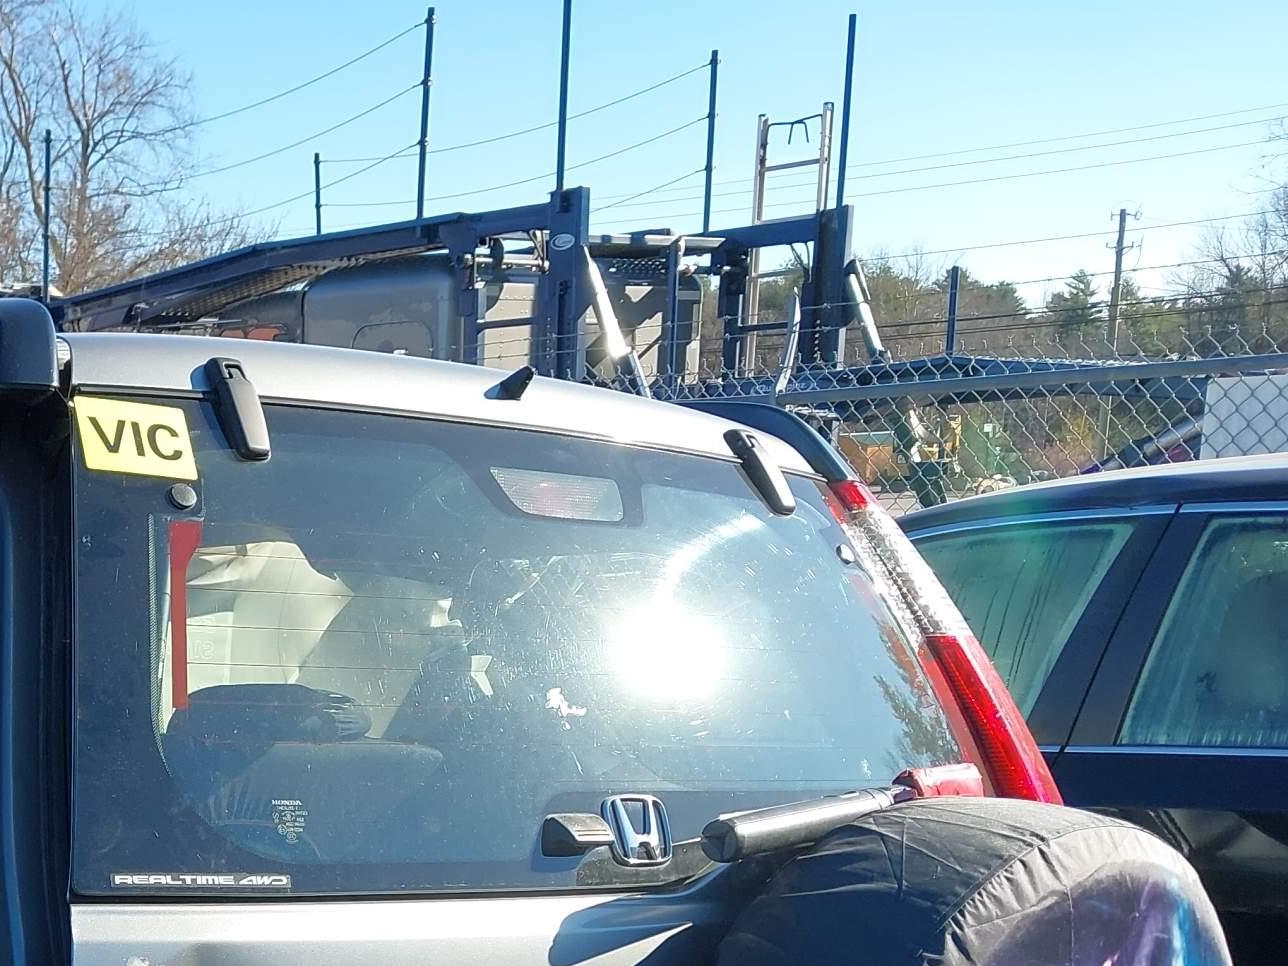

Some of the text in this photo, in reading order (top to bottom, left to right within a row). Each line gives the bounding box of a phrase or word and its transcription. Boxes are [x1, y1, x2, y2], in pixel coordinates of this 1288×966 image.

[87, 415, 183, 461] VIC
[114, 874, 288, 885] REALTIME 4WD
